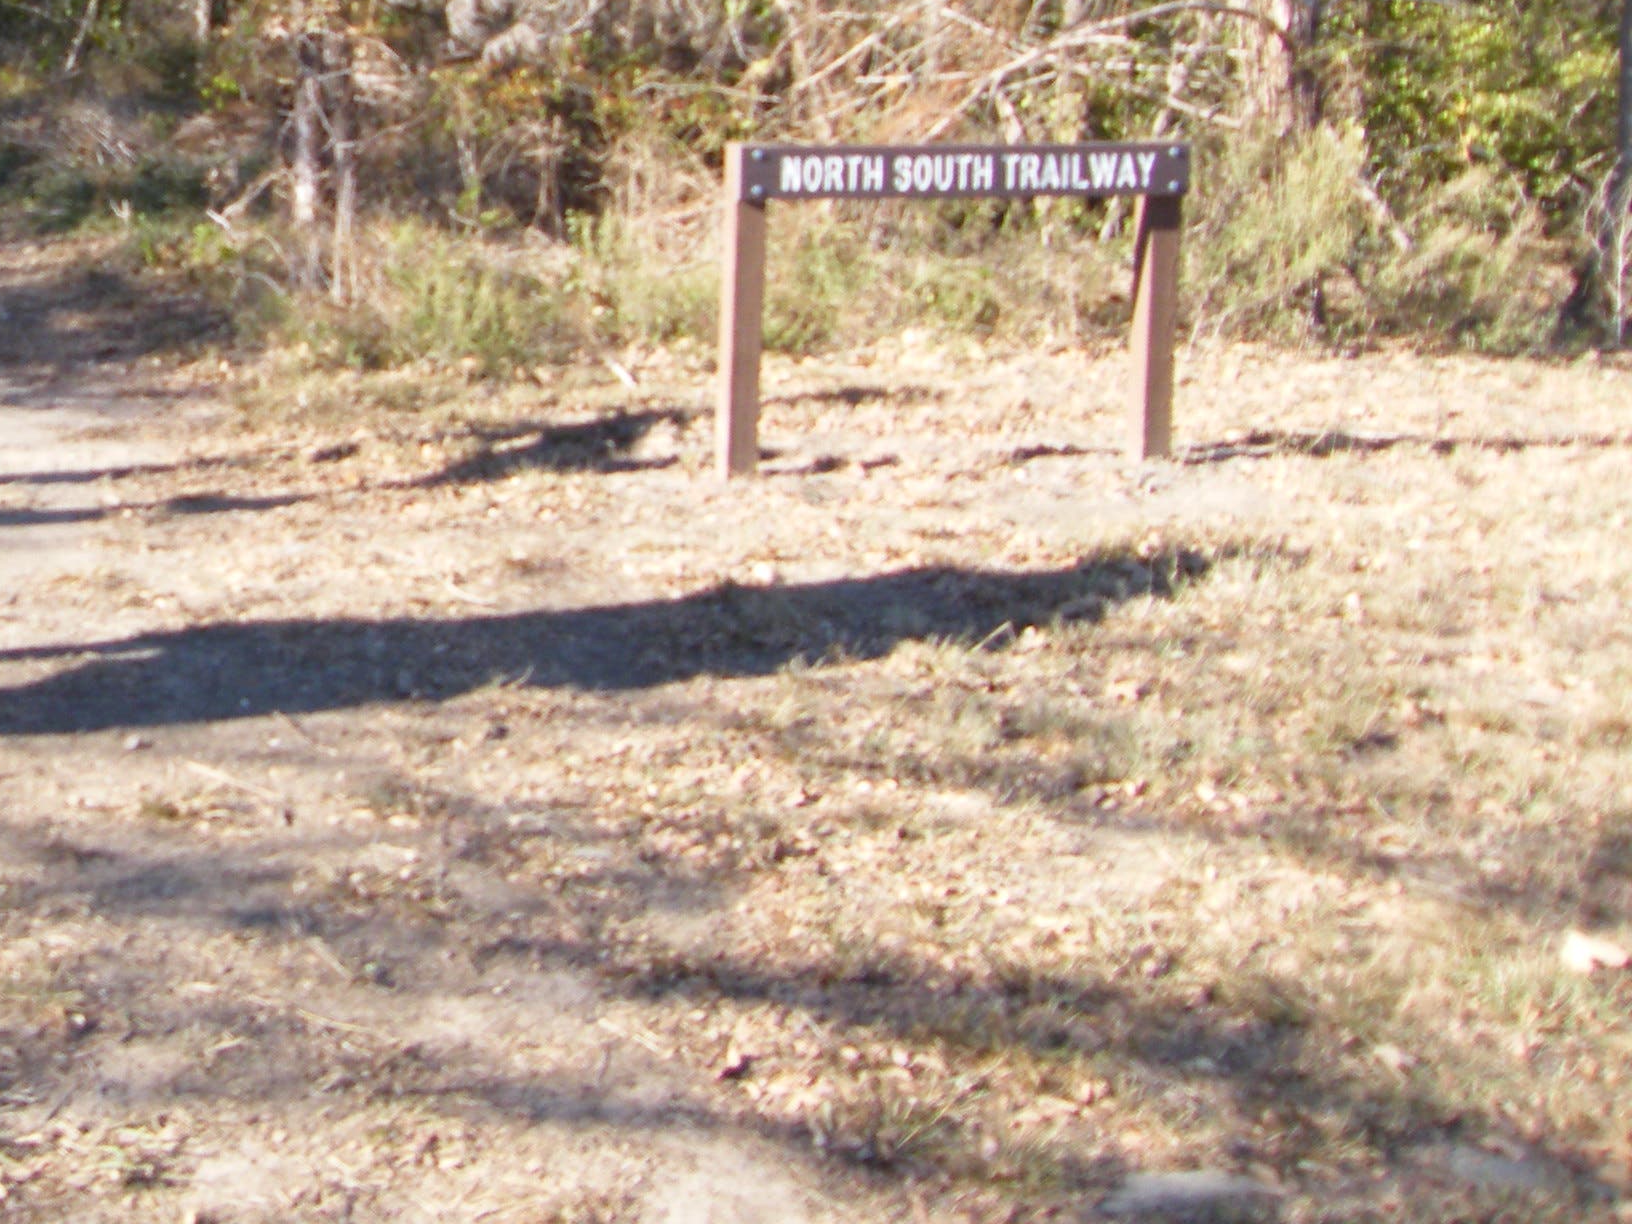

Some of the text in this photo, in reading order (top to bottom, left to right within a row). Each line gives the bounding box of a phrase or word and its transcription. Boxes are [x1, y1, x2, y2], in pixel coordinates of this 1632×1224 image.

[779, 152, 1155, 192] NORTH SOUTH TRAILWAY
